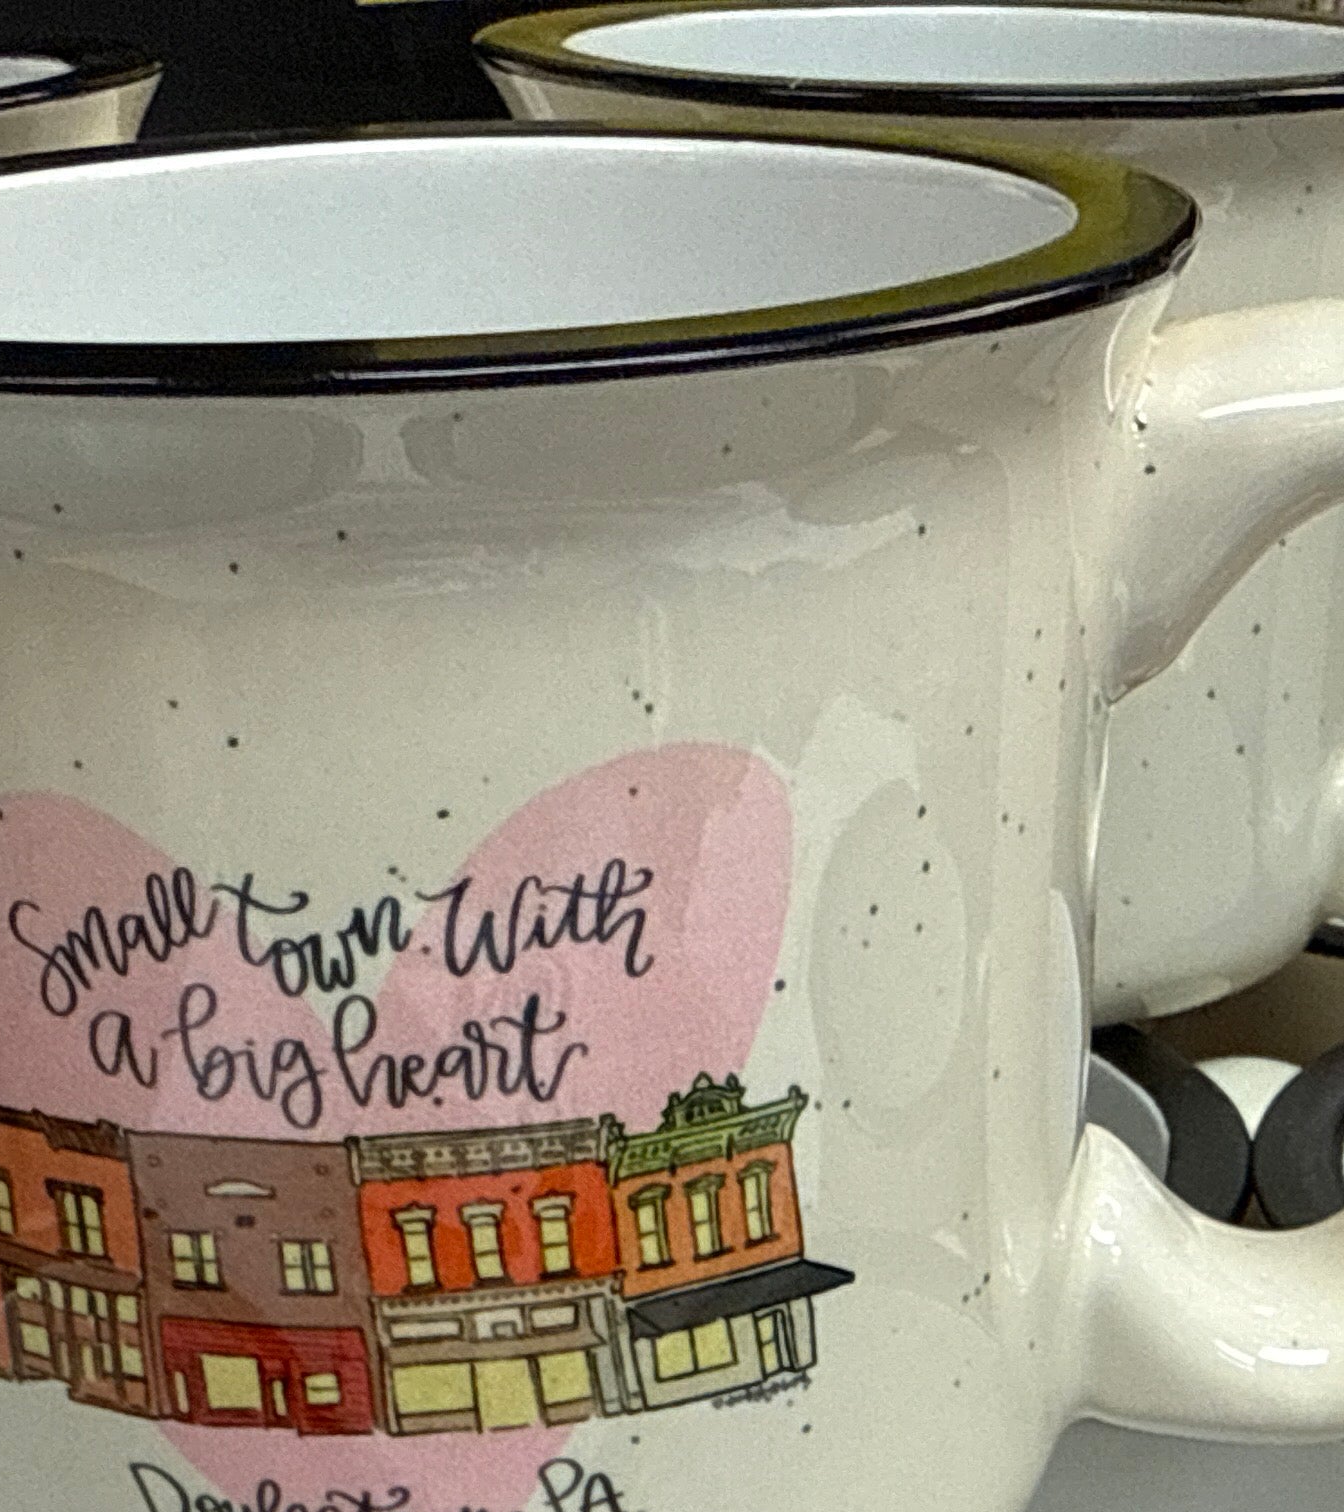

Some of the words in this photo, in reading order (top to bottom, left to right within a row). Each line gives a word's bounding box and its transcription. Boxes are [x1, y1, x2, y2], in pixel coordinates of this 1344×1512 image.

[10, 867, 219, 1017] Small
[212, 873, 412, 996] town
[415, 858, 654, 977] With
[162, 983, 327, 1129] big
[331, 993, 588, 1108] heart
